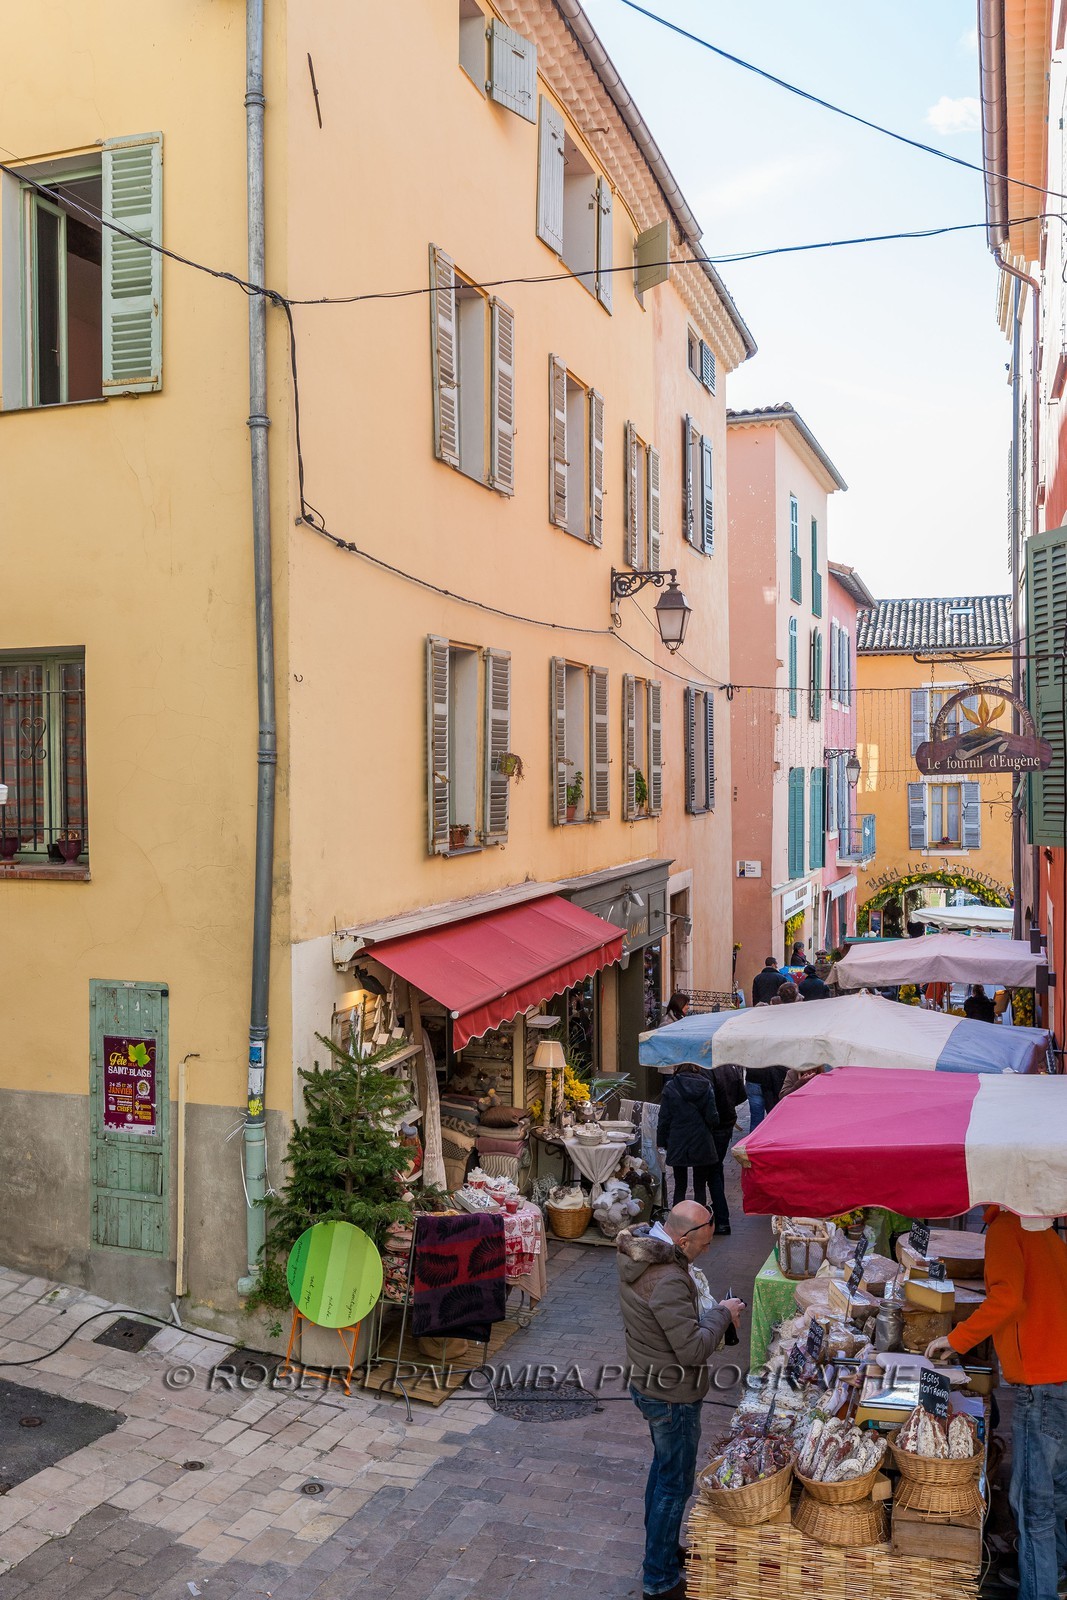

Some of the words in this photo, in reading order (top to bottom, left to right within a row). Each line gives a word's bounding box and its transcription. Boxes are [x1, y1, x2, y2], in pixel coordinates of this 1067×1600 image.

[926, 757, 941, 770] Le
[947, 755, 983, 769] fournil
[989, 754, 1041, 771] d'Eugène
[109, 1052, 128, 1066] Fête
